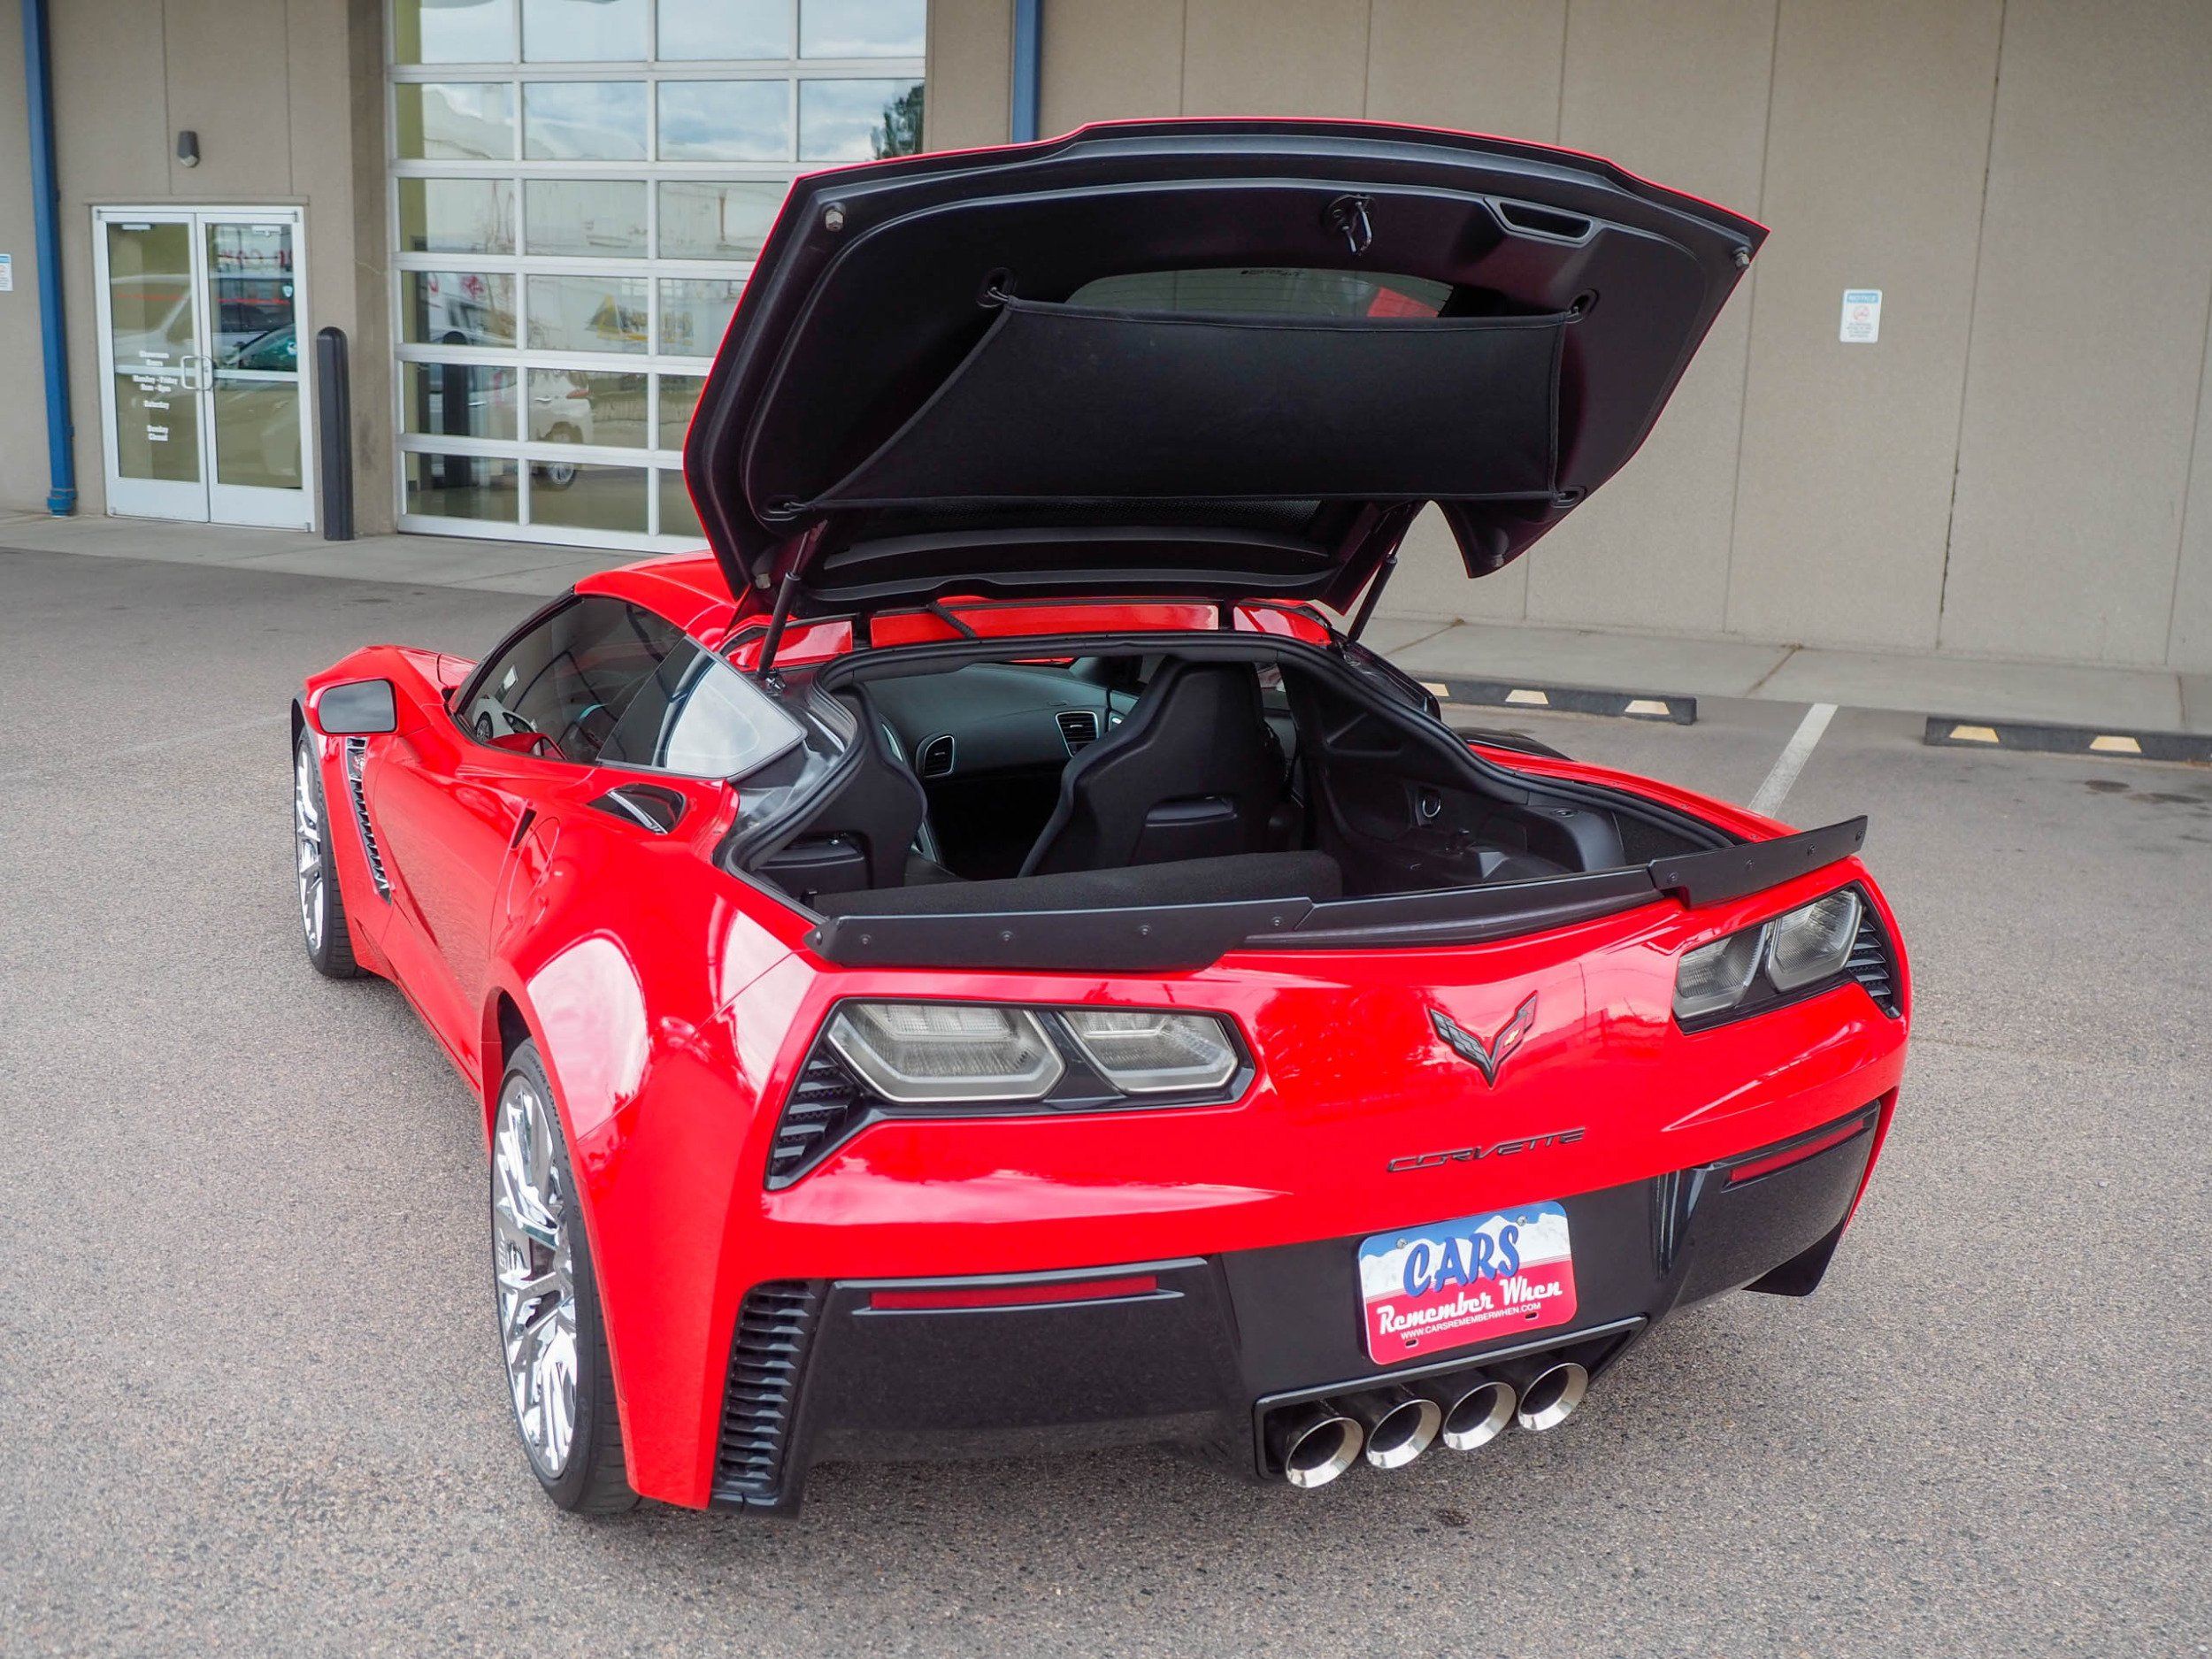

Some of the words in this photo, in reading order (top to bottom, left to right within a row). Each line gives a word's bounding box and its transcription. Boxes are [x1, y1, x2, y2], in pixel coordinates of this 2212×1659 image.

[1387, 1126, 1586, 1172] CORVETTE
[1403, 1225, 1519, 1298] CARS
[1377, 1292, 1494, 1335] Remember
[1499, 1276, 1563, 1306] When
[1401, 1302, 1541, 1340] WWW.CARSREMEMBERWHEN.COM
